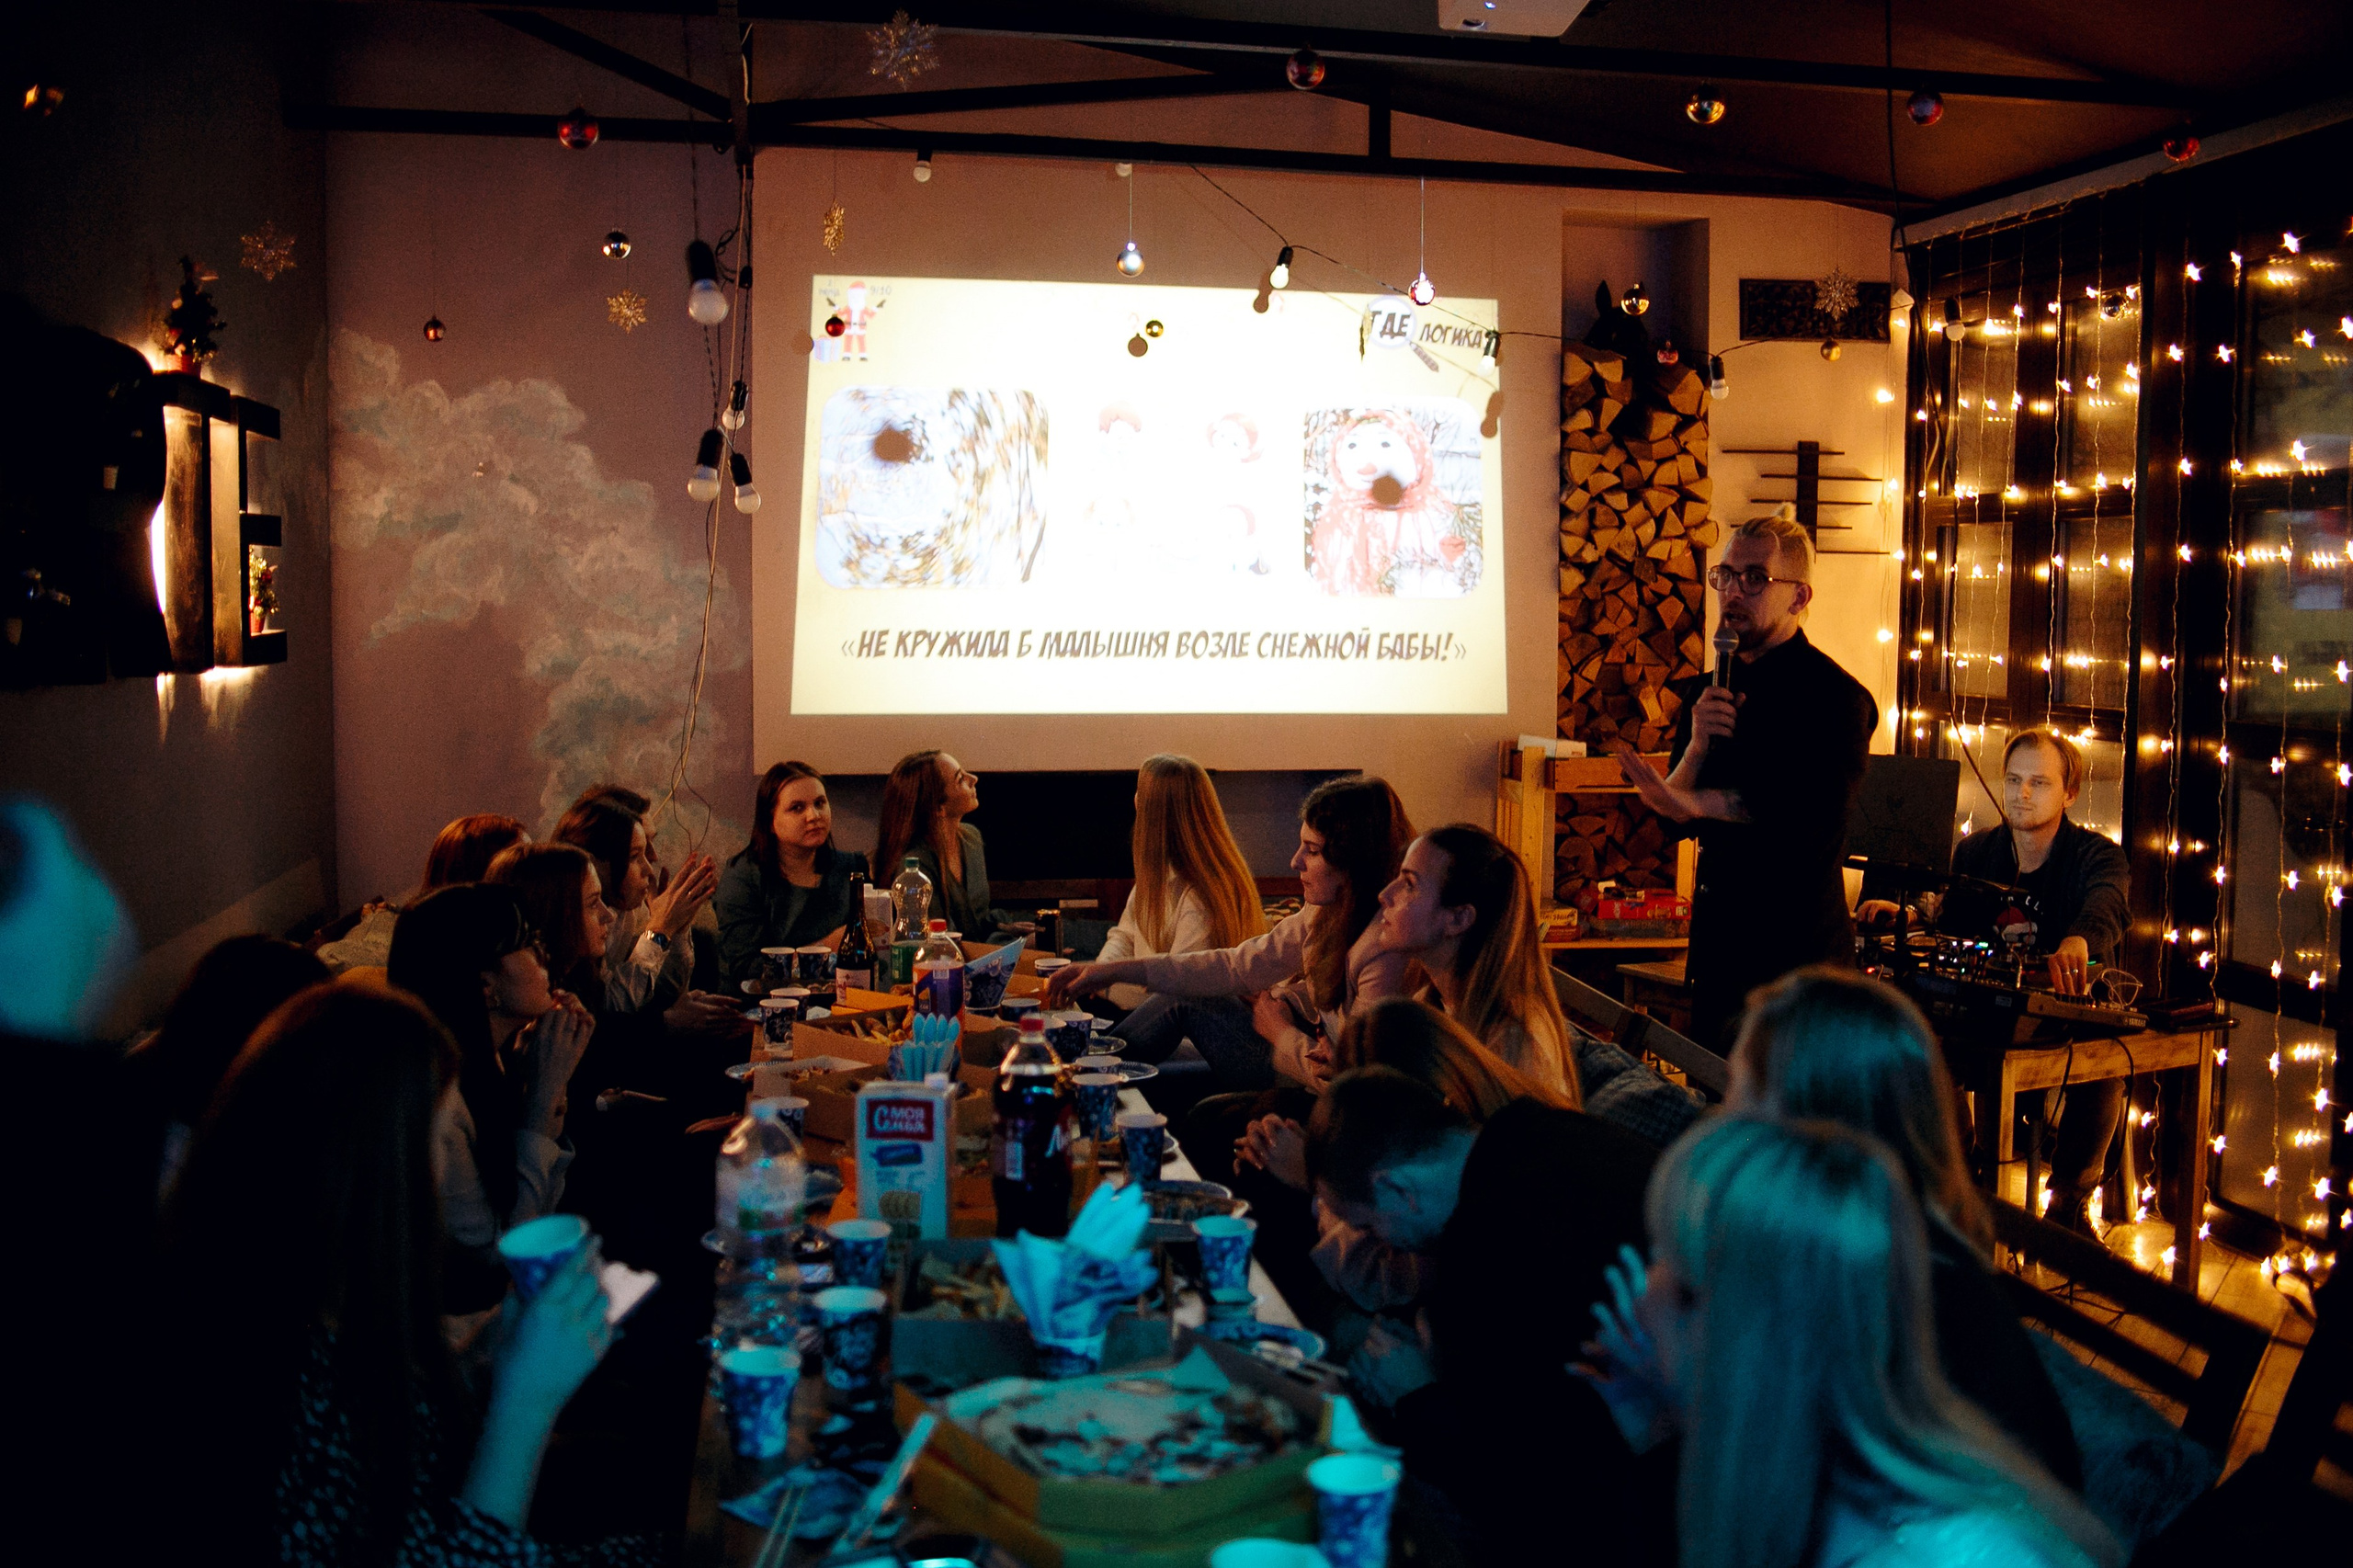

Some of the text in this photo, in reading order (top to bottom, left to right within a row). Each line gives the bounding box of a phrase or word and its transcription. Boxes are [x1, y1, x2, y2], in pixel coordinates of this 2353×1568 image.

[1371, 311, 1411, 339] ГДЕ
[1419, 324, 1483, 348] ЛОГИКА
[893, 630, 1011, 659] КРУЖИЛА
[1017, 630, 1033, 659] Б
[1038, 630, 1171, 660] МАЛЫШНЯ
[1175, 630, 1252, 660] ВОЗЛЕ
[1256, 627, 1371, 661] СНЕЖНОЙ
